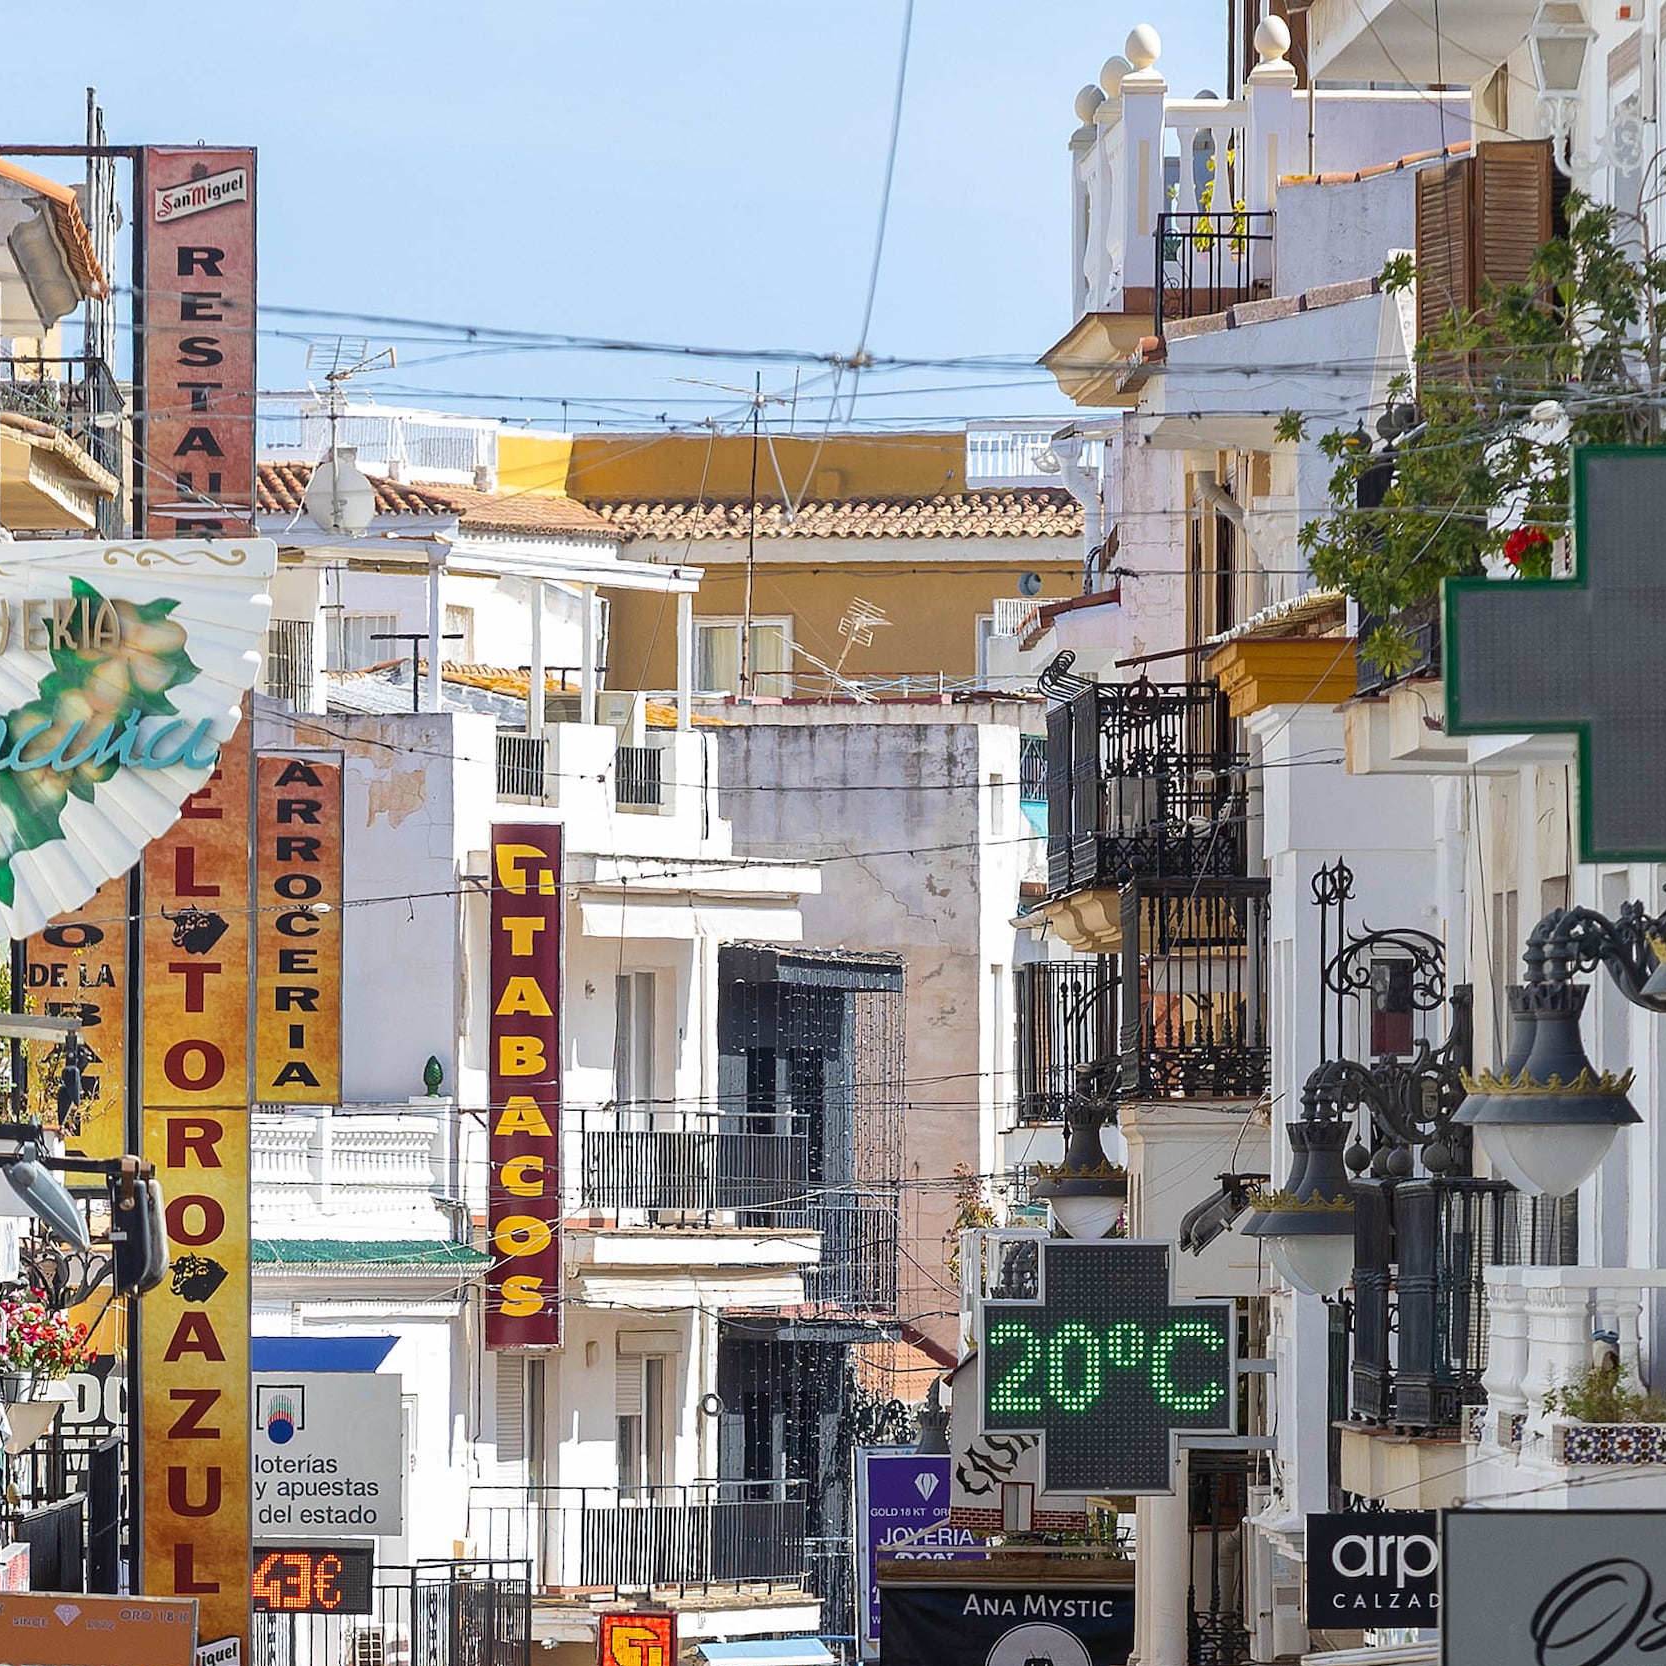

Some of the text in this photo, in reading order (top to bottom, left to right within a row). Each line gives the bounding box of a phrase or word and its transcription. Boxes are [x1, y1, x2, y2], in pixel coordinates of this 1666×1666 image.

[271, 759, 323, 1088] ARROCERIA
[163, 962, 226, 1247] TORO
[494, 916, 554, 1318] TABACOS
[163, 1311, 226, 1595] AZUL
[254, 1454, 338, 1474] loterías
[255, 1478, 379, 1501] y apuestas
[258, 1504, 377, 1524] del estado
[870, 1507, 899, 1517] GOLD
[900, 1507, 911, 1517] 18
[912, 1507, 927, 1517] KT
[879, 1526, 975, 1547] JOYERIA
[12, 1616, 49, 1629] SINCE
[120, 1609, 153, 1622] ORO
